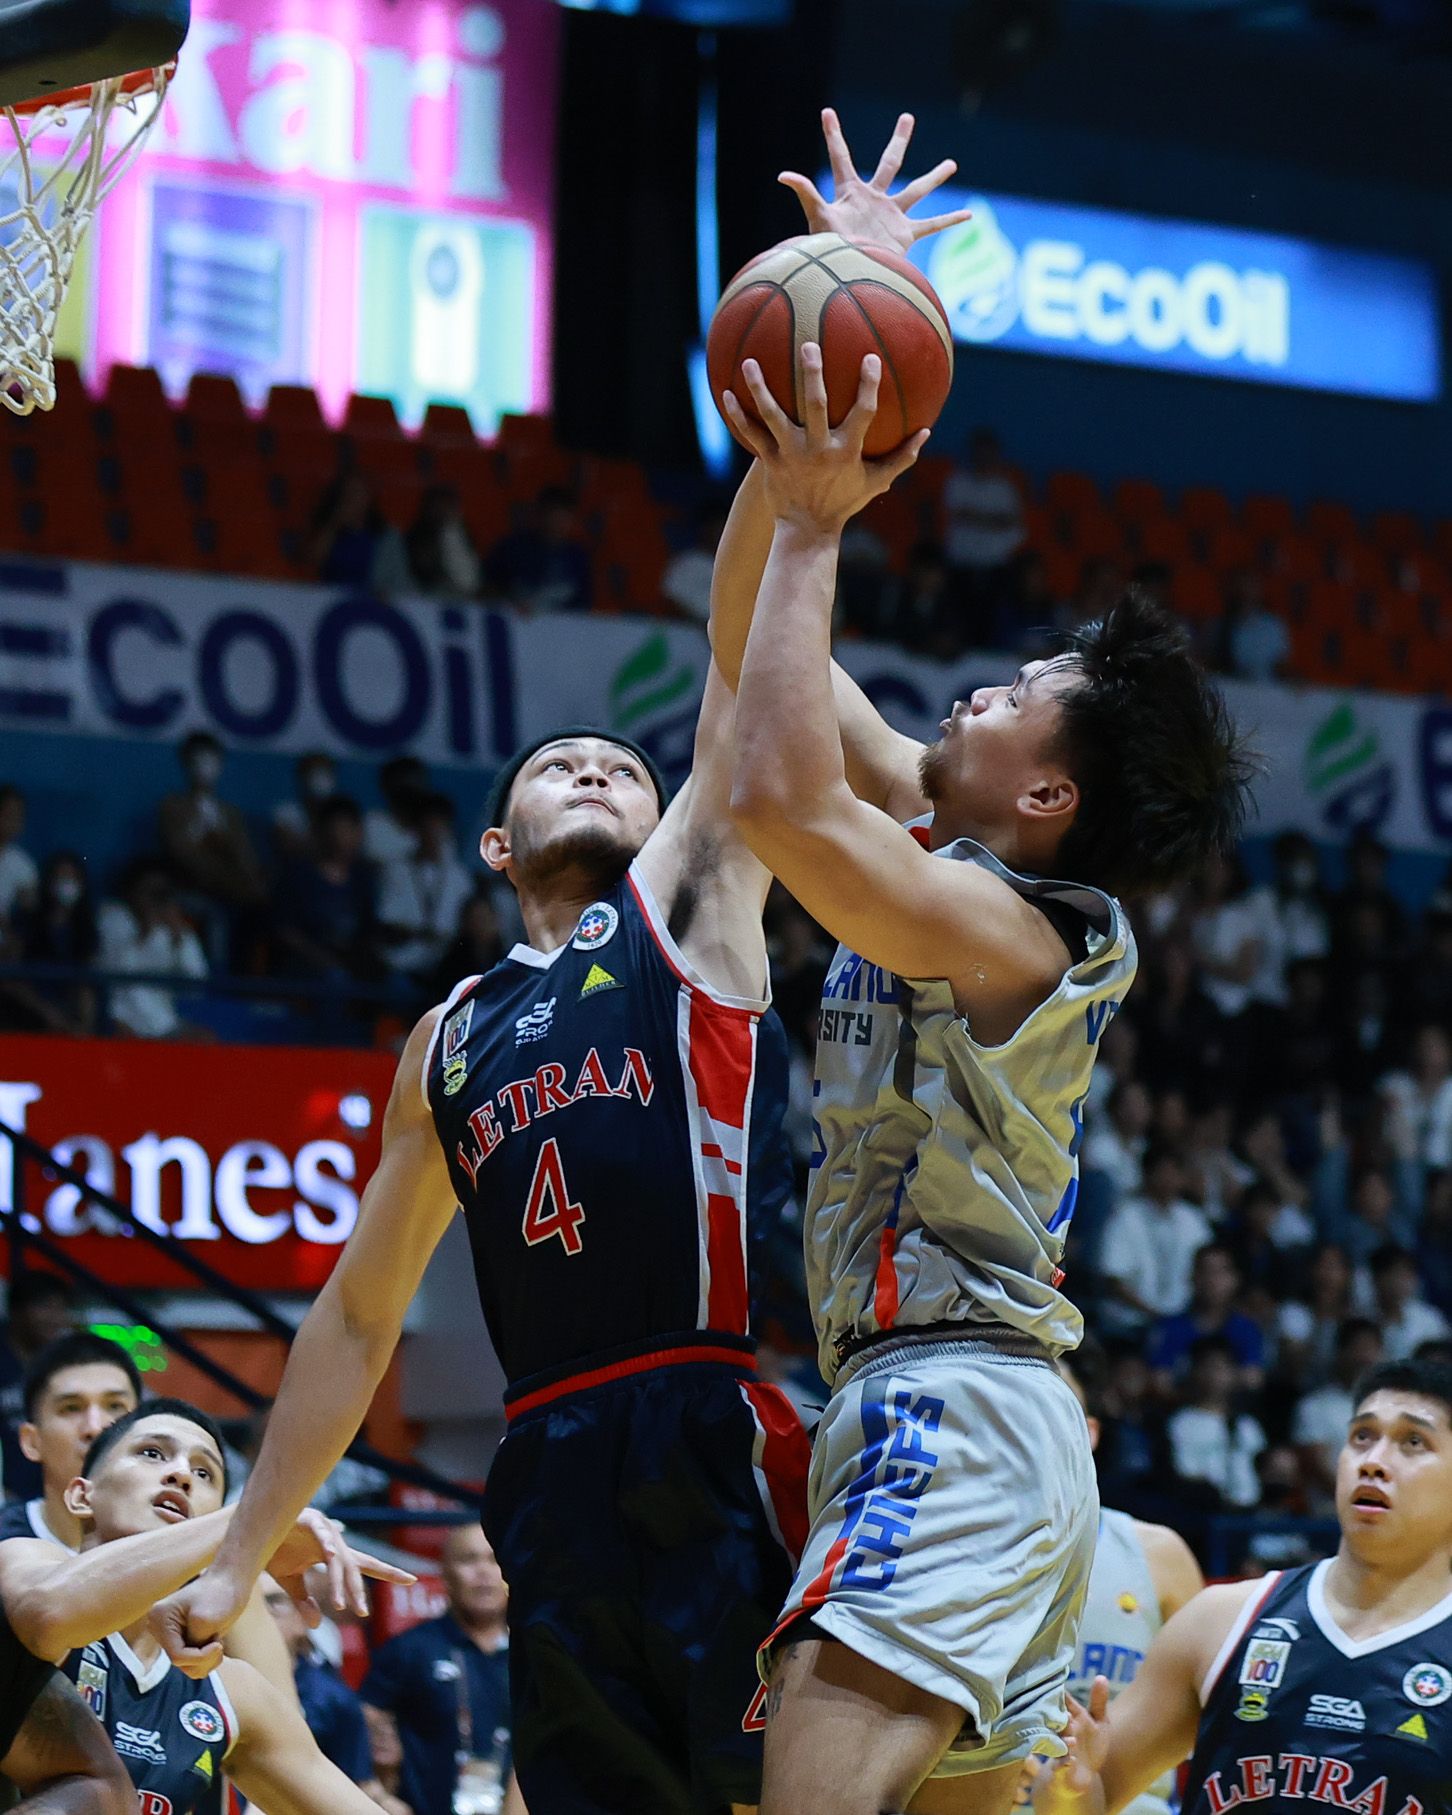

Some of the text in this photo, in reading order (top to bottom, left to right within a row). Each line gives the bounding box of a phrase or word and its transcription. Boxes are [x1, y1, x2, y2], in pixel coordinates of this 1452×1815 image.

[1020, 239, 1291, 367] EcoOil
[456, 1047, 655, 1192] LETRAN
[522, 1137, 586, 1257] 4
[839, 1391, 945, 1592] CHIEFS
[1307, 1694, 1367, 1720] SGA
